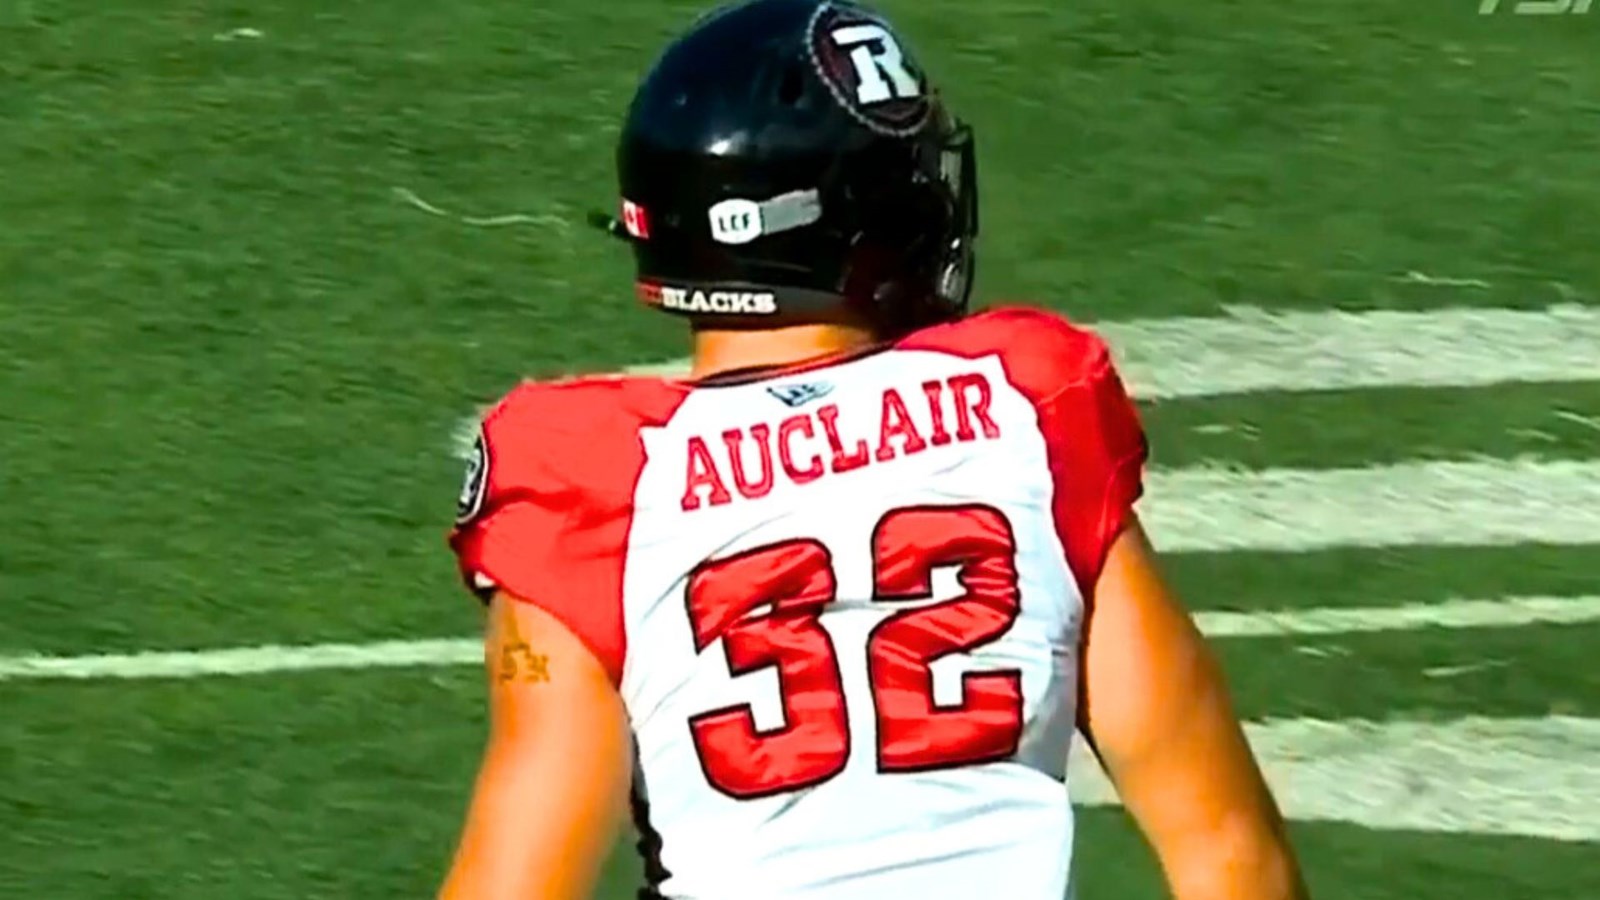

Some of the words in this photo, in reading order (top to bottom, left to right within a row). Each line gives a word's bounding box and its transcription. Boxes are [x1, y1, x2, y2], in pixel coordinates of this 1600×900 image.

[831, 25, 921, 104] R
[661, 286, 778, 314] BLACKS
[681, 373, 1001, 512] AUCLAIR
[684, 502, 1024, 801] 32
